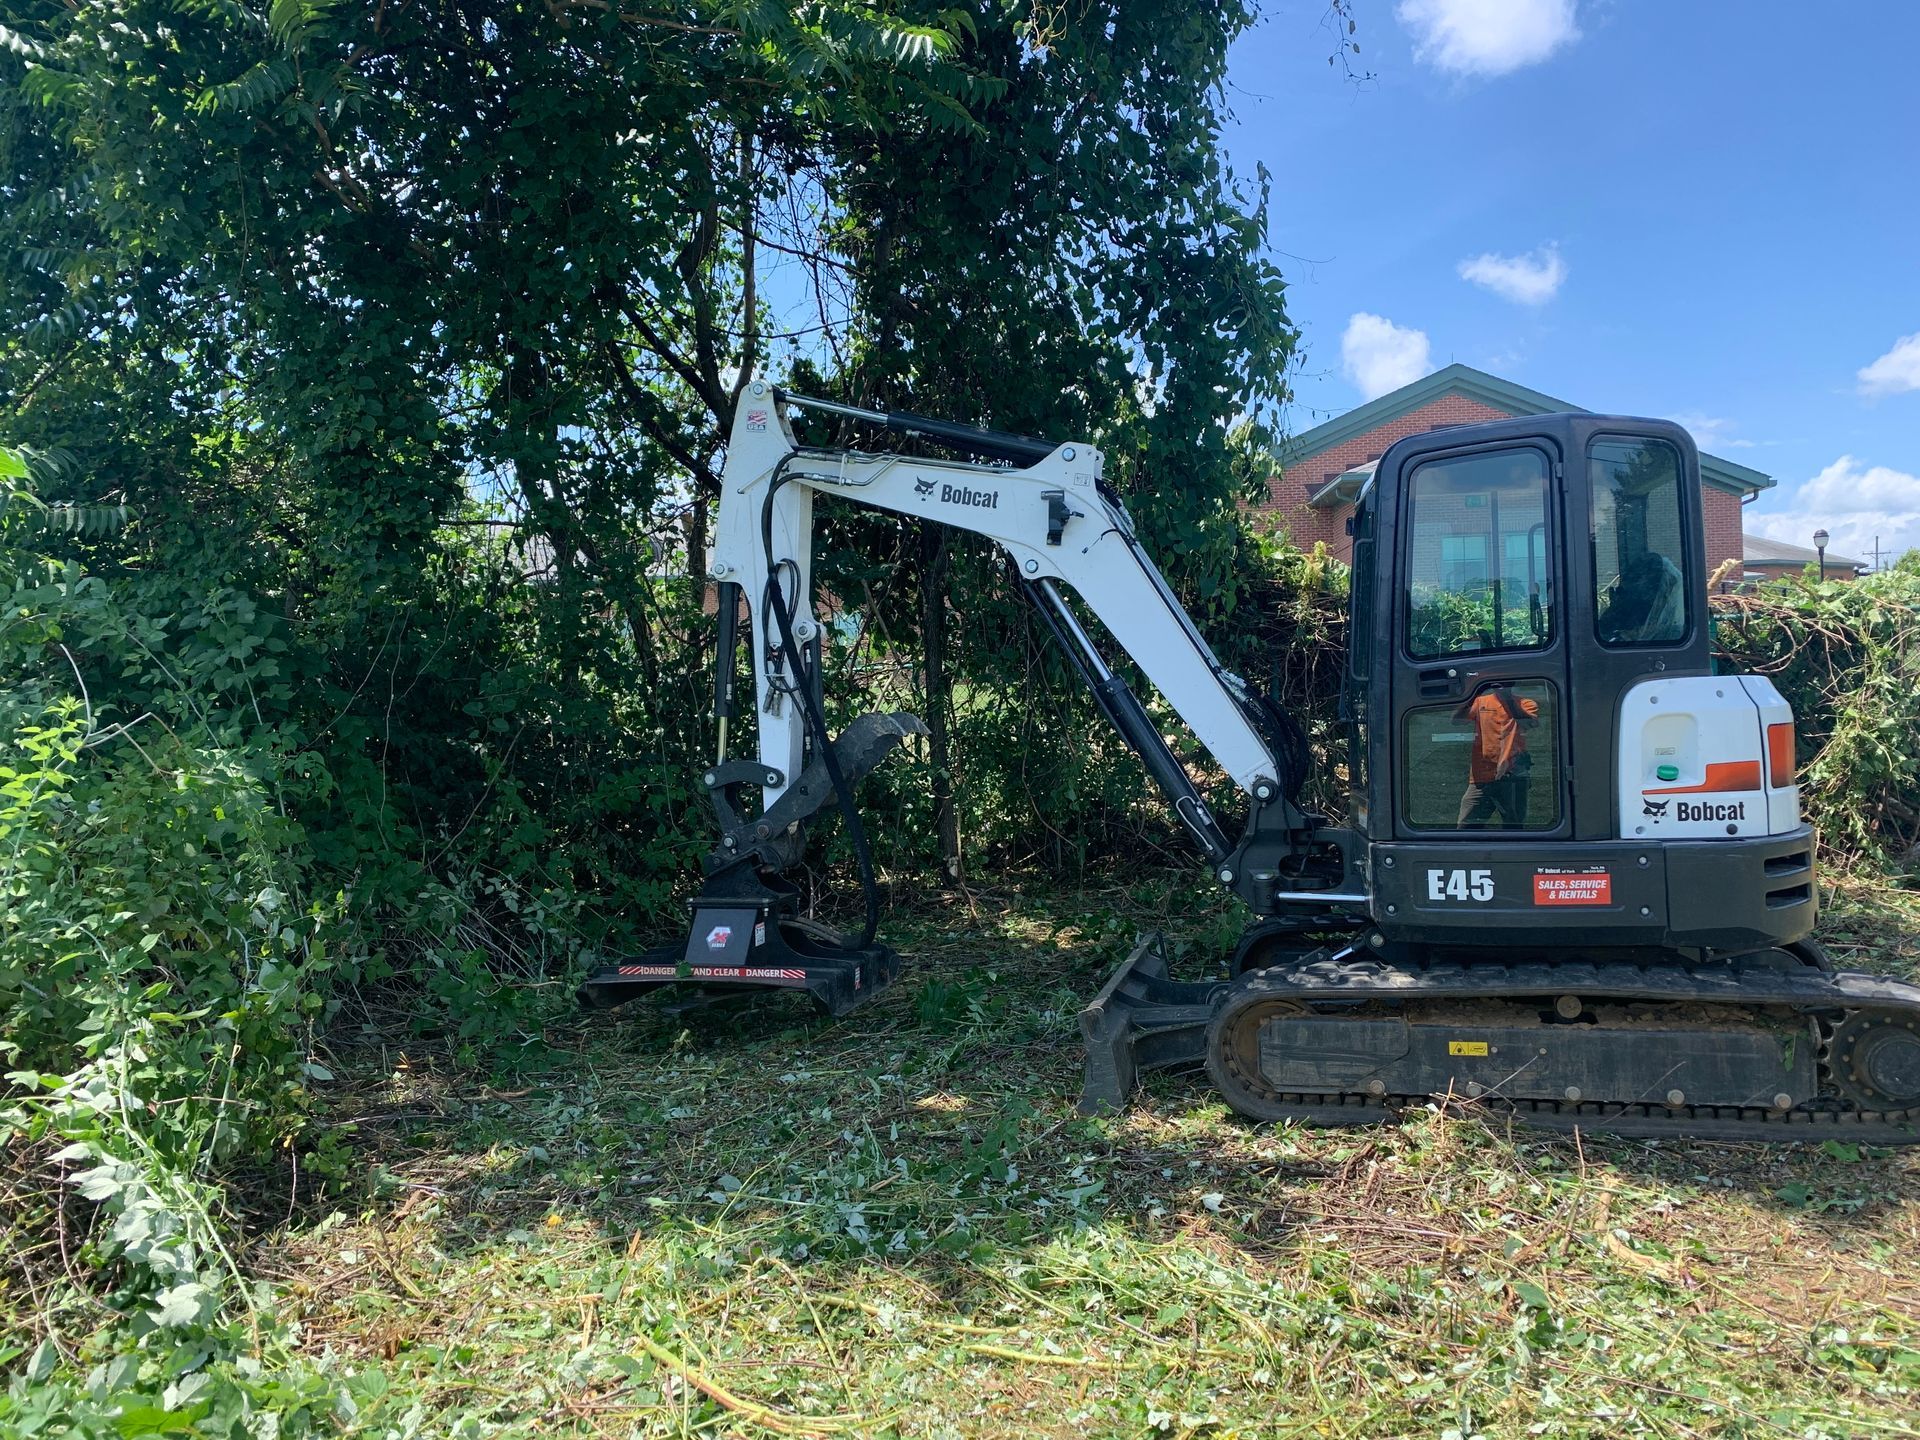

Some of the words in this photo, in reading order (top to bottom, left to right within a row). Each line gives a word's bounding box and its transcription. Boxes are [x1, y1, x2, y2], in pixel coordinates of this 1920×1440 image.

[940, 484, 999, 509] Bobcat
[1677, 801, 1745, 822] Bobcat
[1427, 869, 1495, 901] E45
[1538, 880, 1568, 889] SALES,
[1569, 880, 1607, 889] SERVICE
[1549, 890, 1556, 899] &
[1559, 890, 1598, 899] RENTALS
[643, 966, 676, 975] DANGER
[713, 968, 740, 976] CLEAR
[745, 968, 780, 978] DANGER
